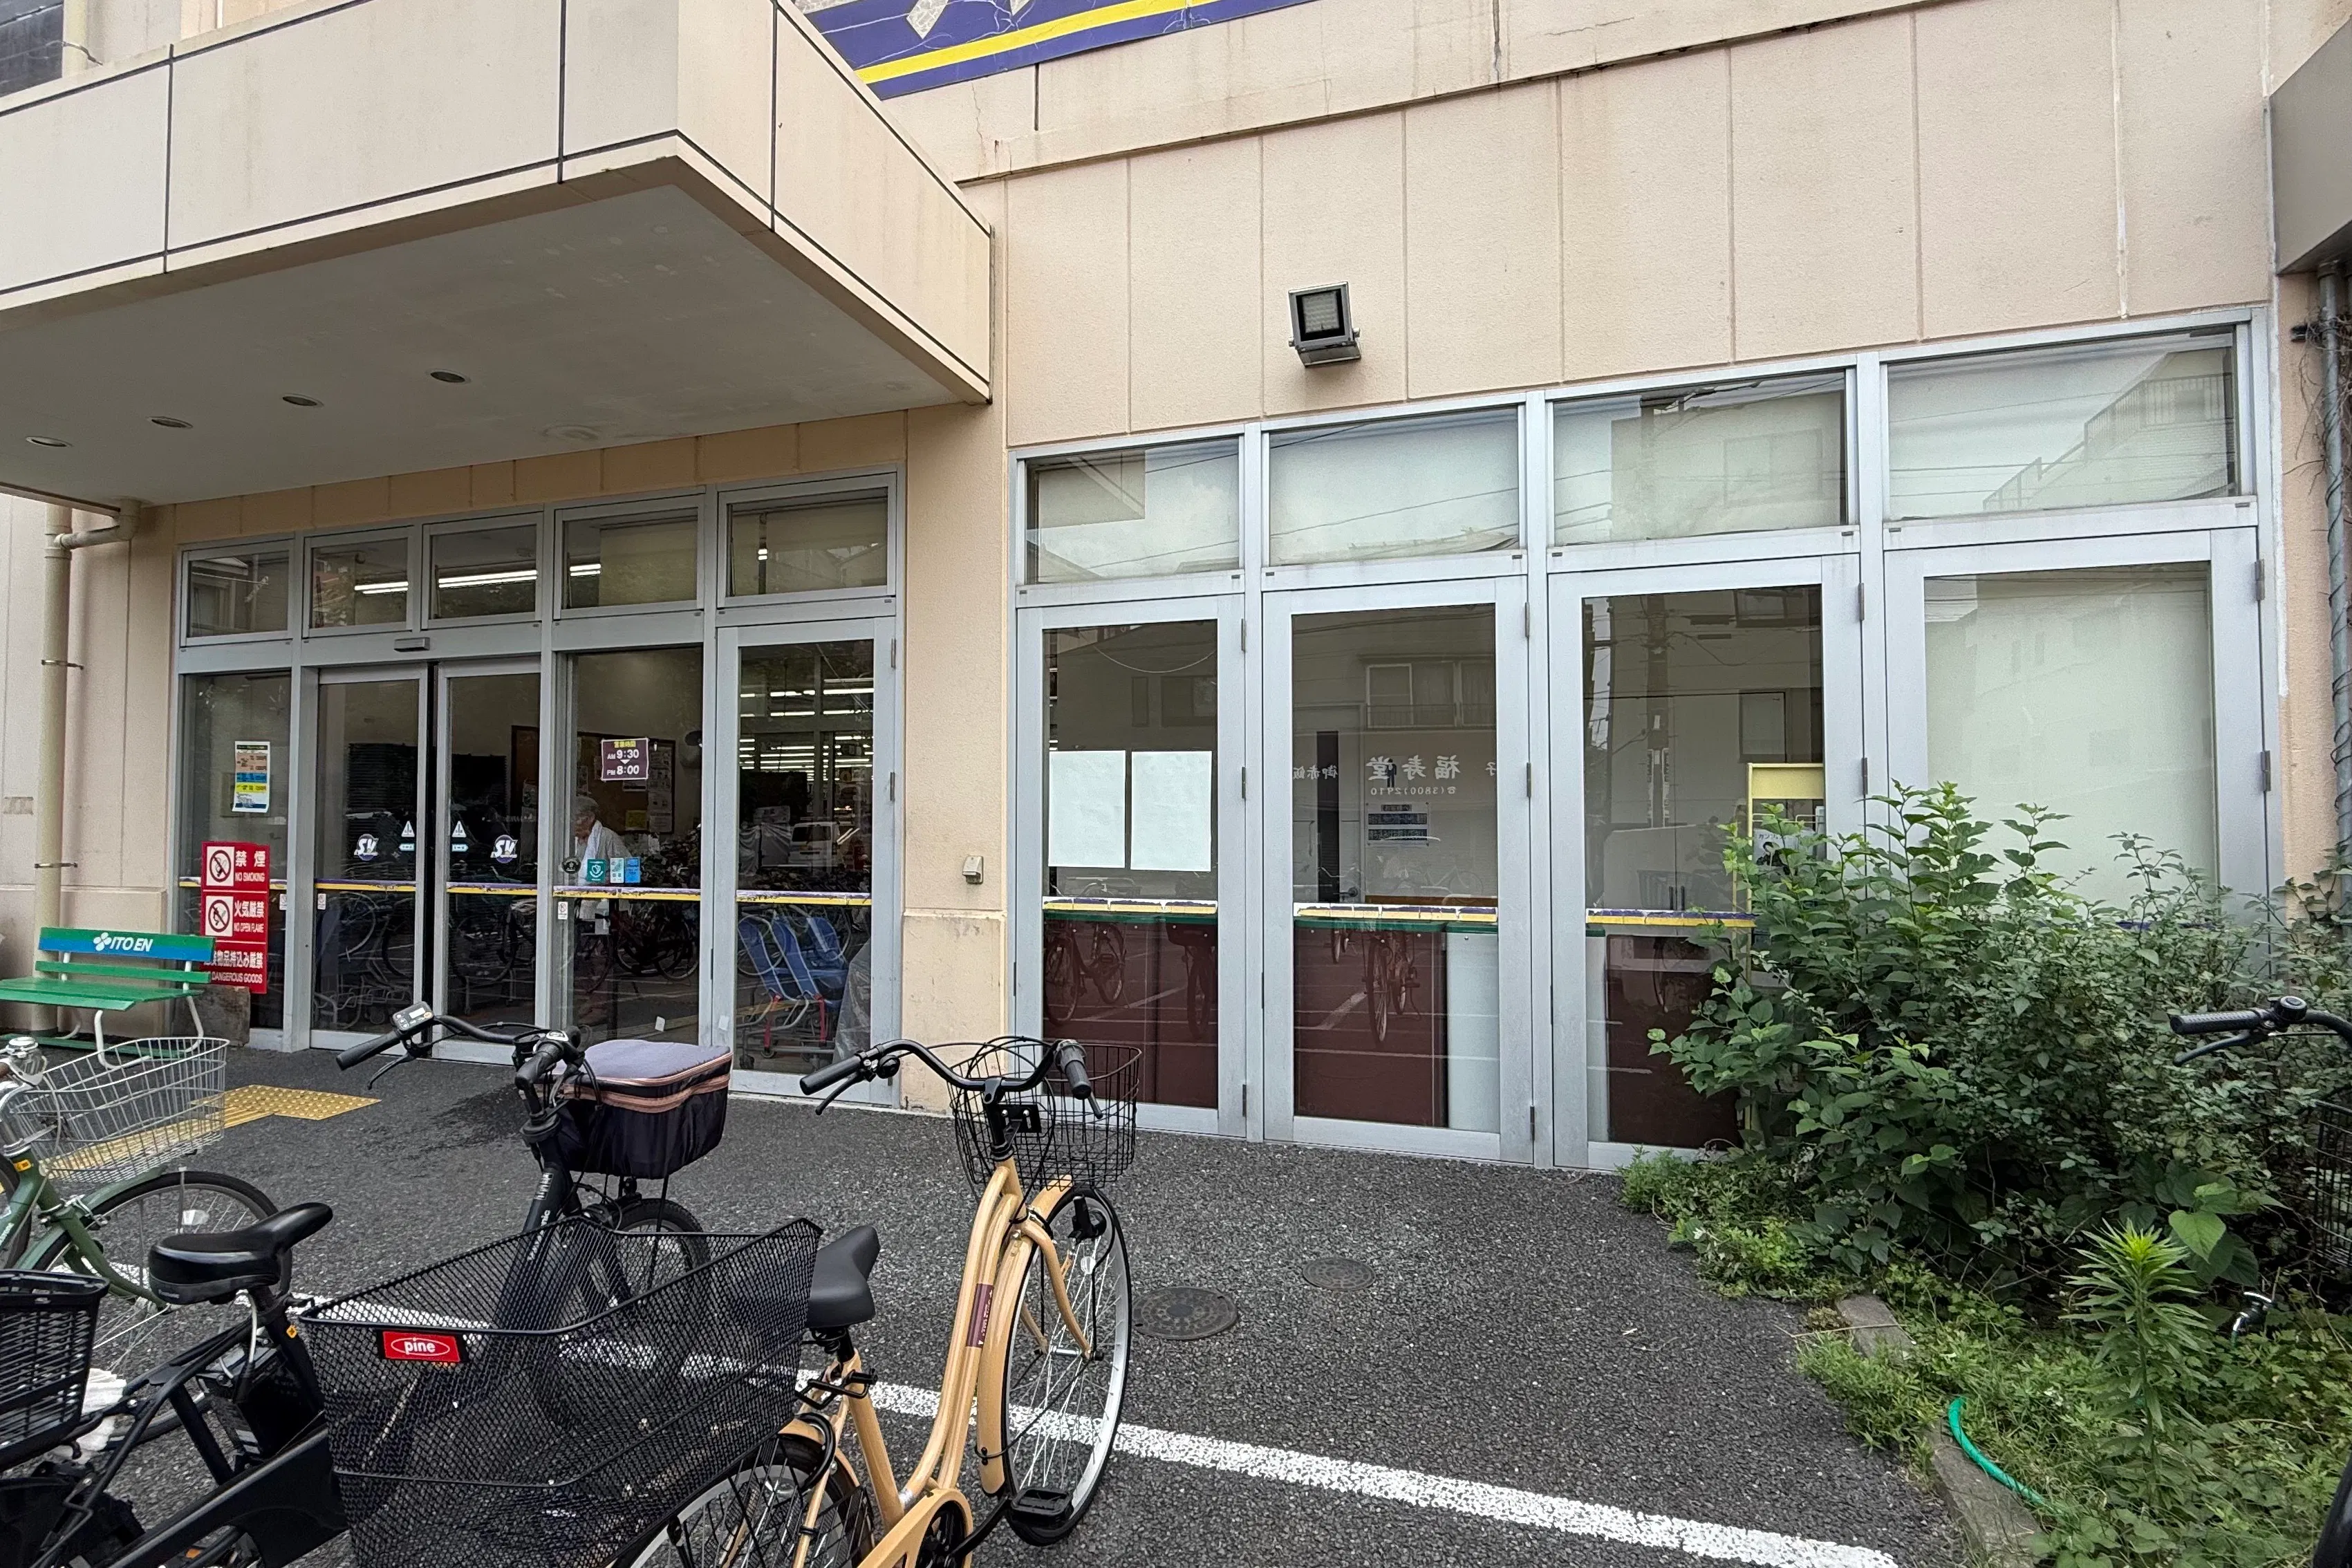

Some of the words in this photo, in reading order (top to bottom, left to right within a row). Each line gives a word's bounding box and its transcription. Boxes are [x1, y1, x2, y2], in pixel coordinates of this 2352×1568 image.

[617, 749, 640, 759] 9:30
[617, 765, 640, 775] 8:00
[235, 850, 266, 868] 禁煙
[235, 872, 243, 881] NO
[243, 872, 265, 882] SMOKING
[234, 900, 264, 918] 火気厳禁
[234, 922, 240, 932] NO
[240, 922, 251, 932] OPEN
[109, 936, 134, 951] ITO
[133, 938, 153, 952] EN
[211, 971, 243, 982] DANGEROUS
[243, 973, 263, 984] GOODS
[404, 1337, 436, 1355] pine
